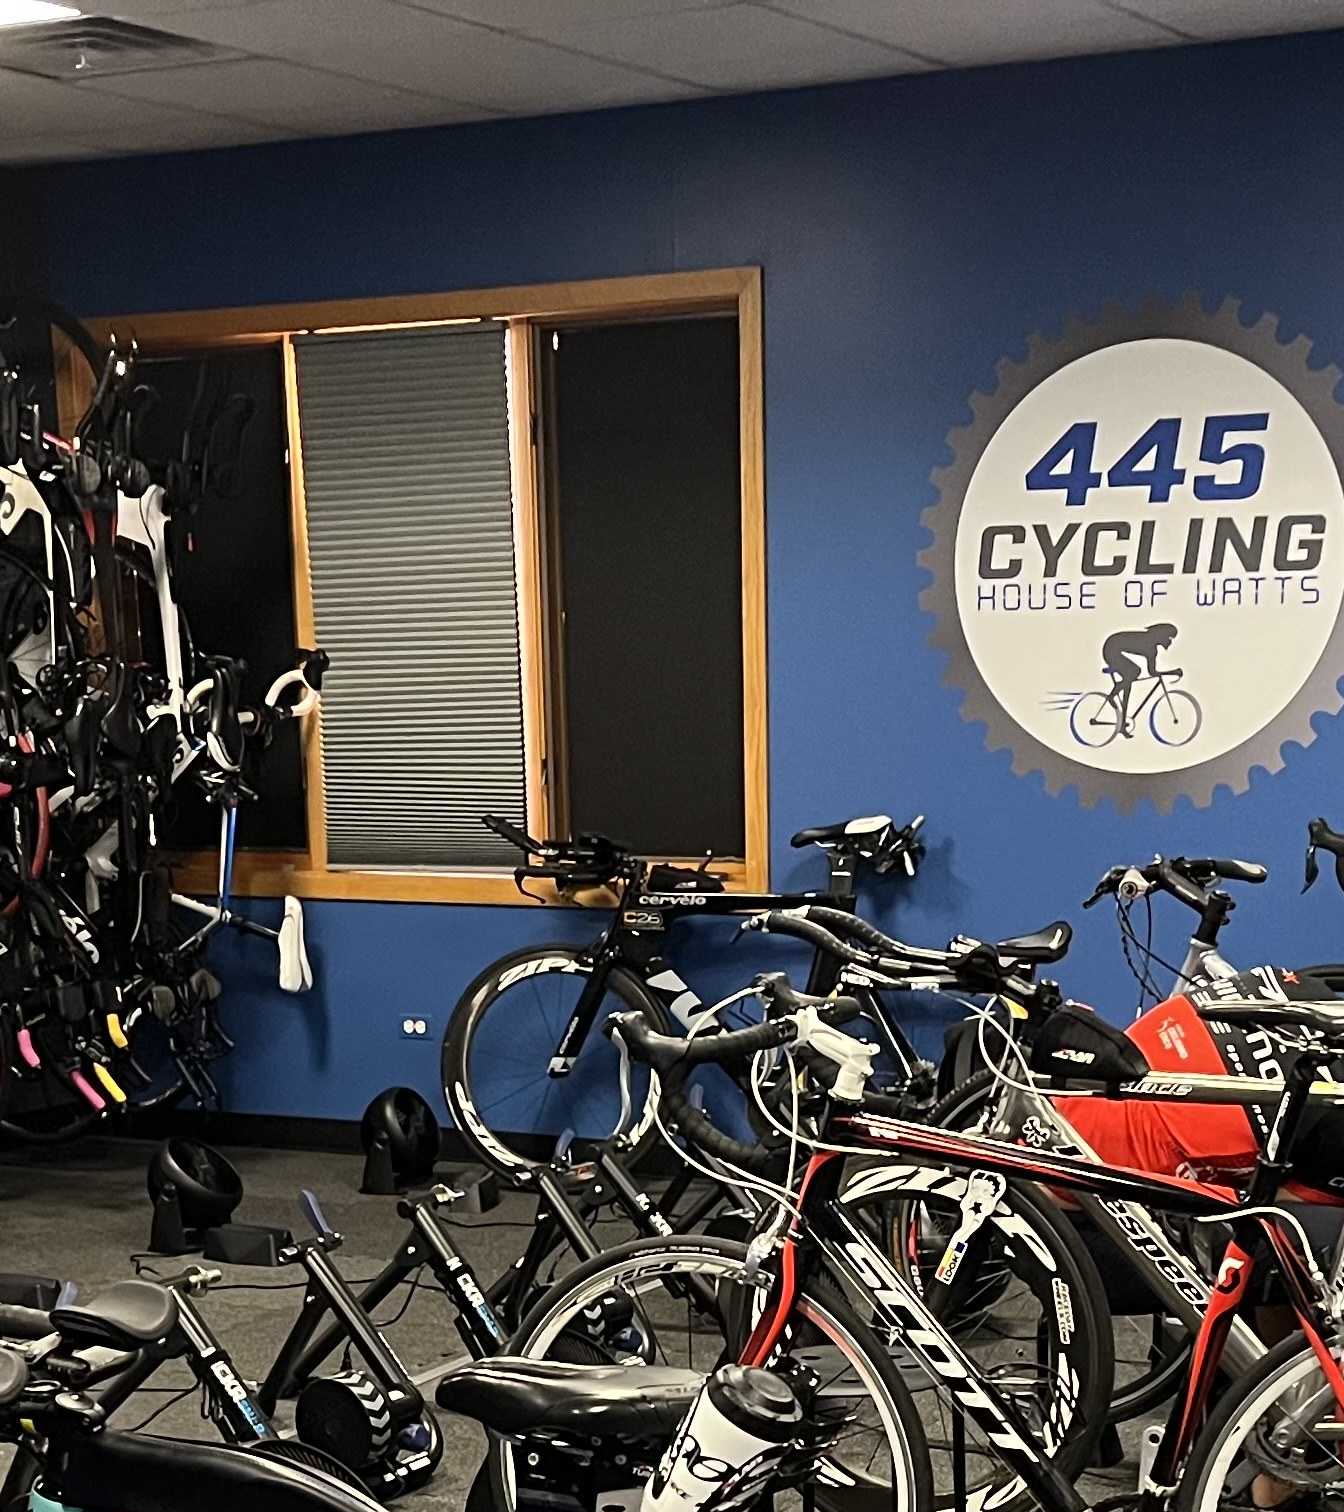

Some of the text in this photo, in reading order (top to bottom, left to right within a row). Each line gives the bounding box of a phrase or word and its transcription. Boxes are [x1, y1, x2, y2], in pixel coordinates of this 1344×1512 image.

[1025, 412, 1270, 506] 445
[978, 514, 1327, 579] CYCLING
[977, 576, 1320, 610] HOUSE OF WATTS
[623, 911, 663, 926] C26
[843, 1242, 1039, 1463] SCOTT
